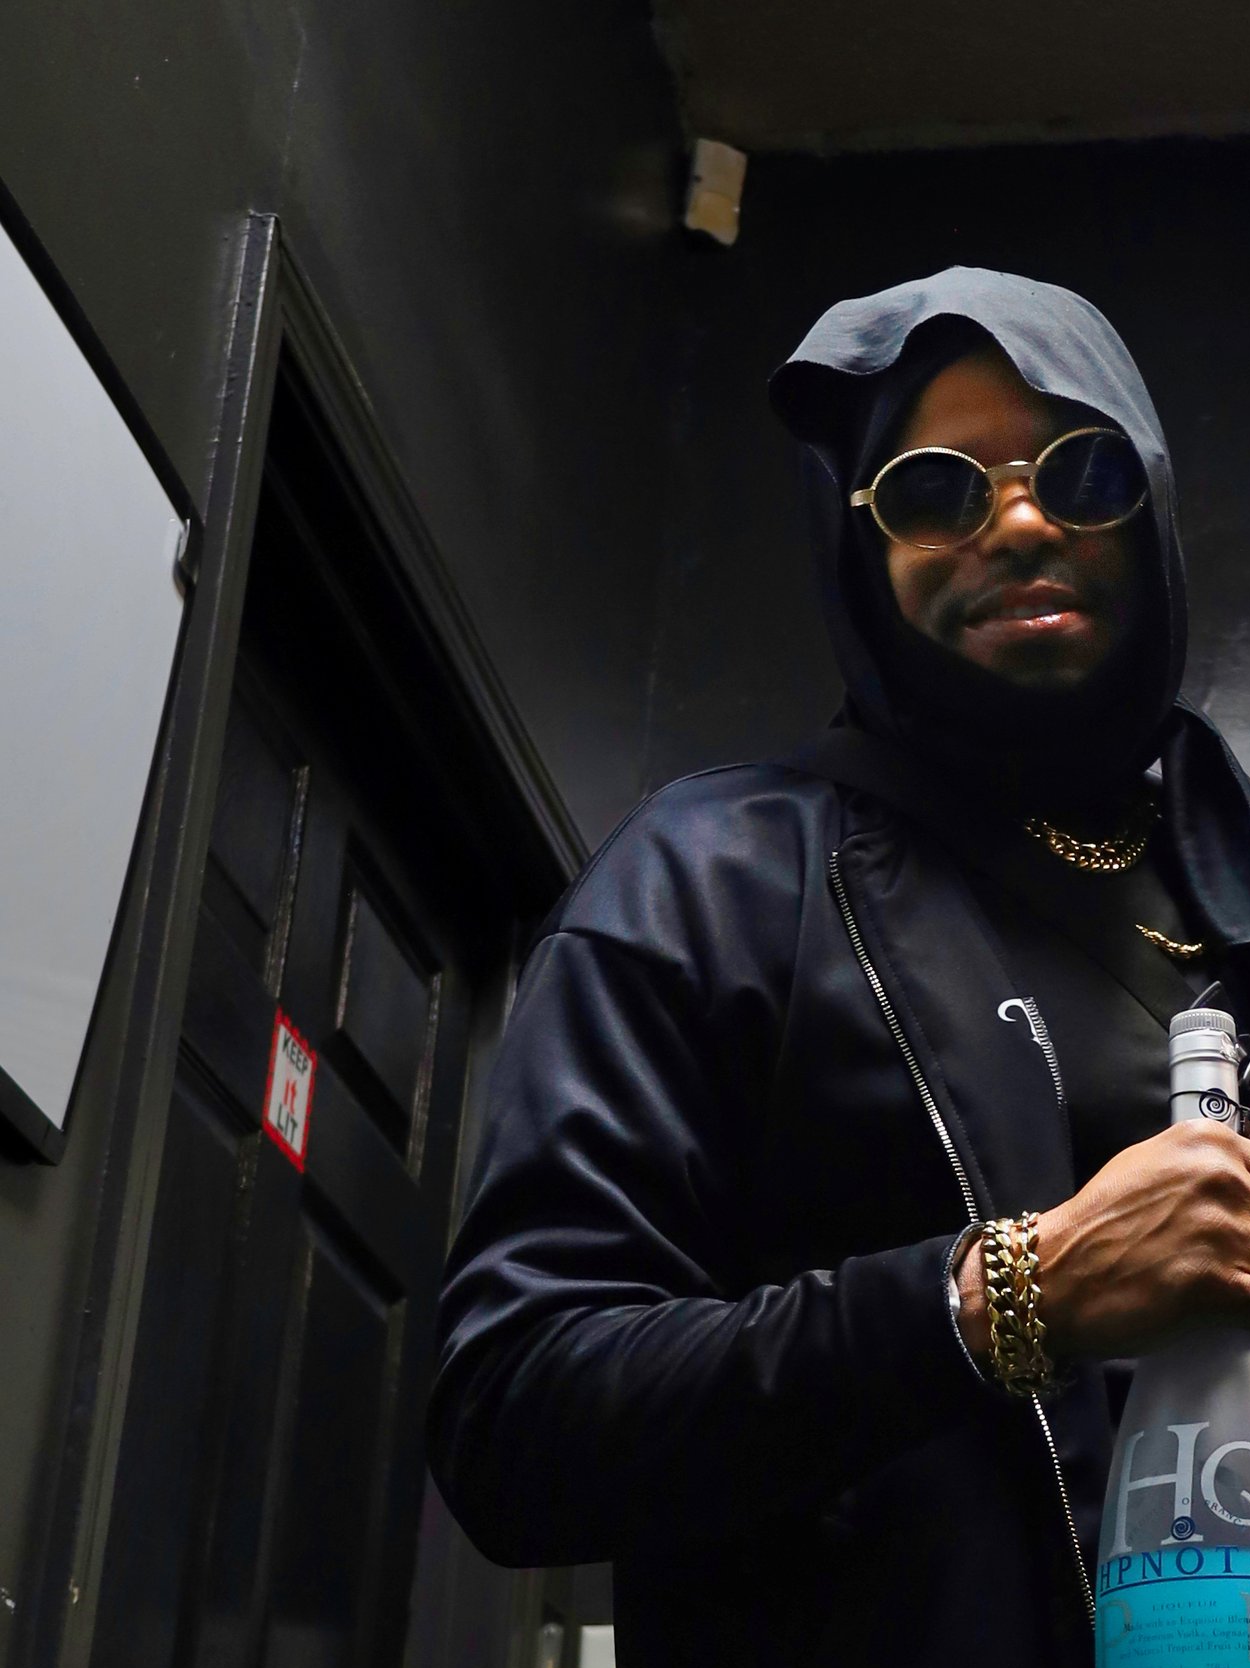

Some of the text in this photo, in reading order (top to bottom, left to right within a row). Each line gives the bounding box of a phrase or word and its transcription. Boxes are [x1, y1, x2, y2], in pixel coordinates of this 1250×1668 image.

[281, 1034, 309, 1075] KEEP
[277, 1102, 298, 1144] LIT
[1167, 1640, 1203, 1654] Tropical
[1207, 1641, 1231, 1651] Fruit
